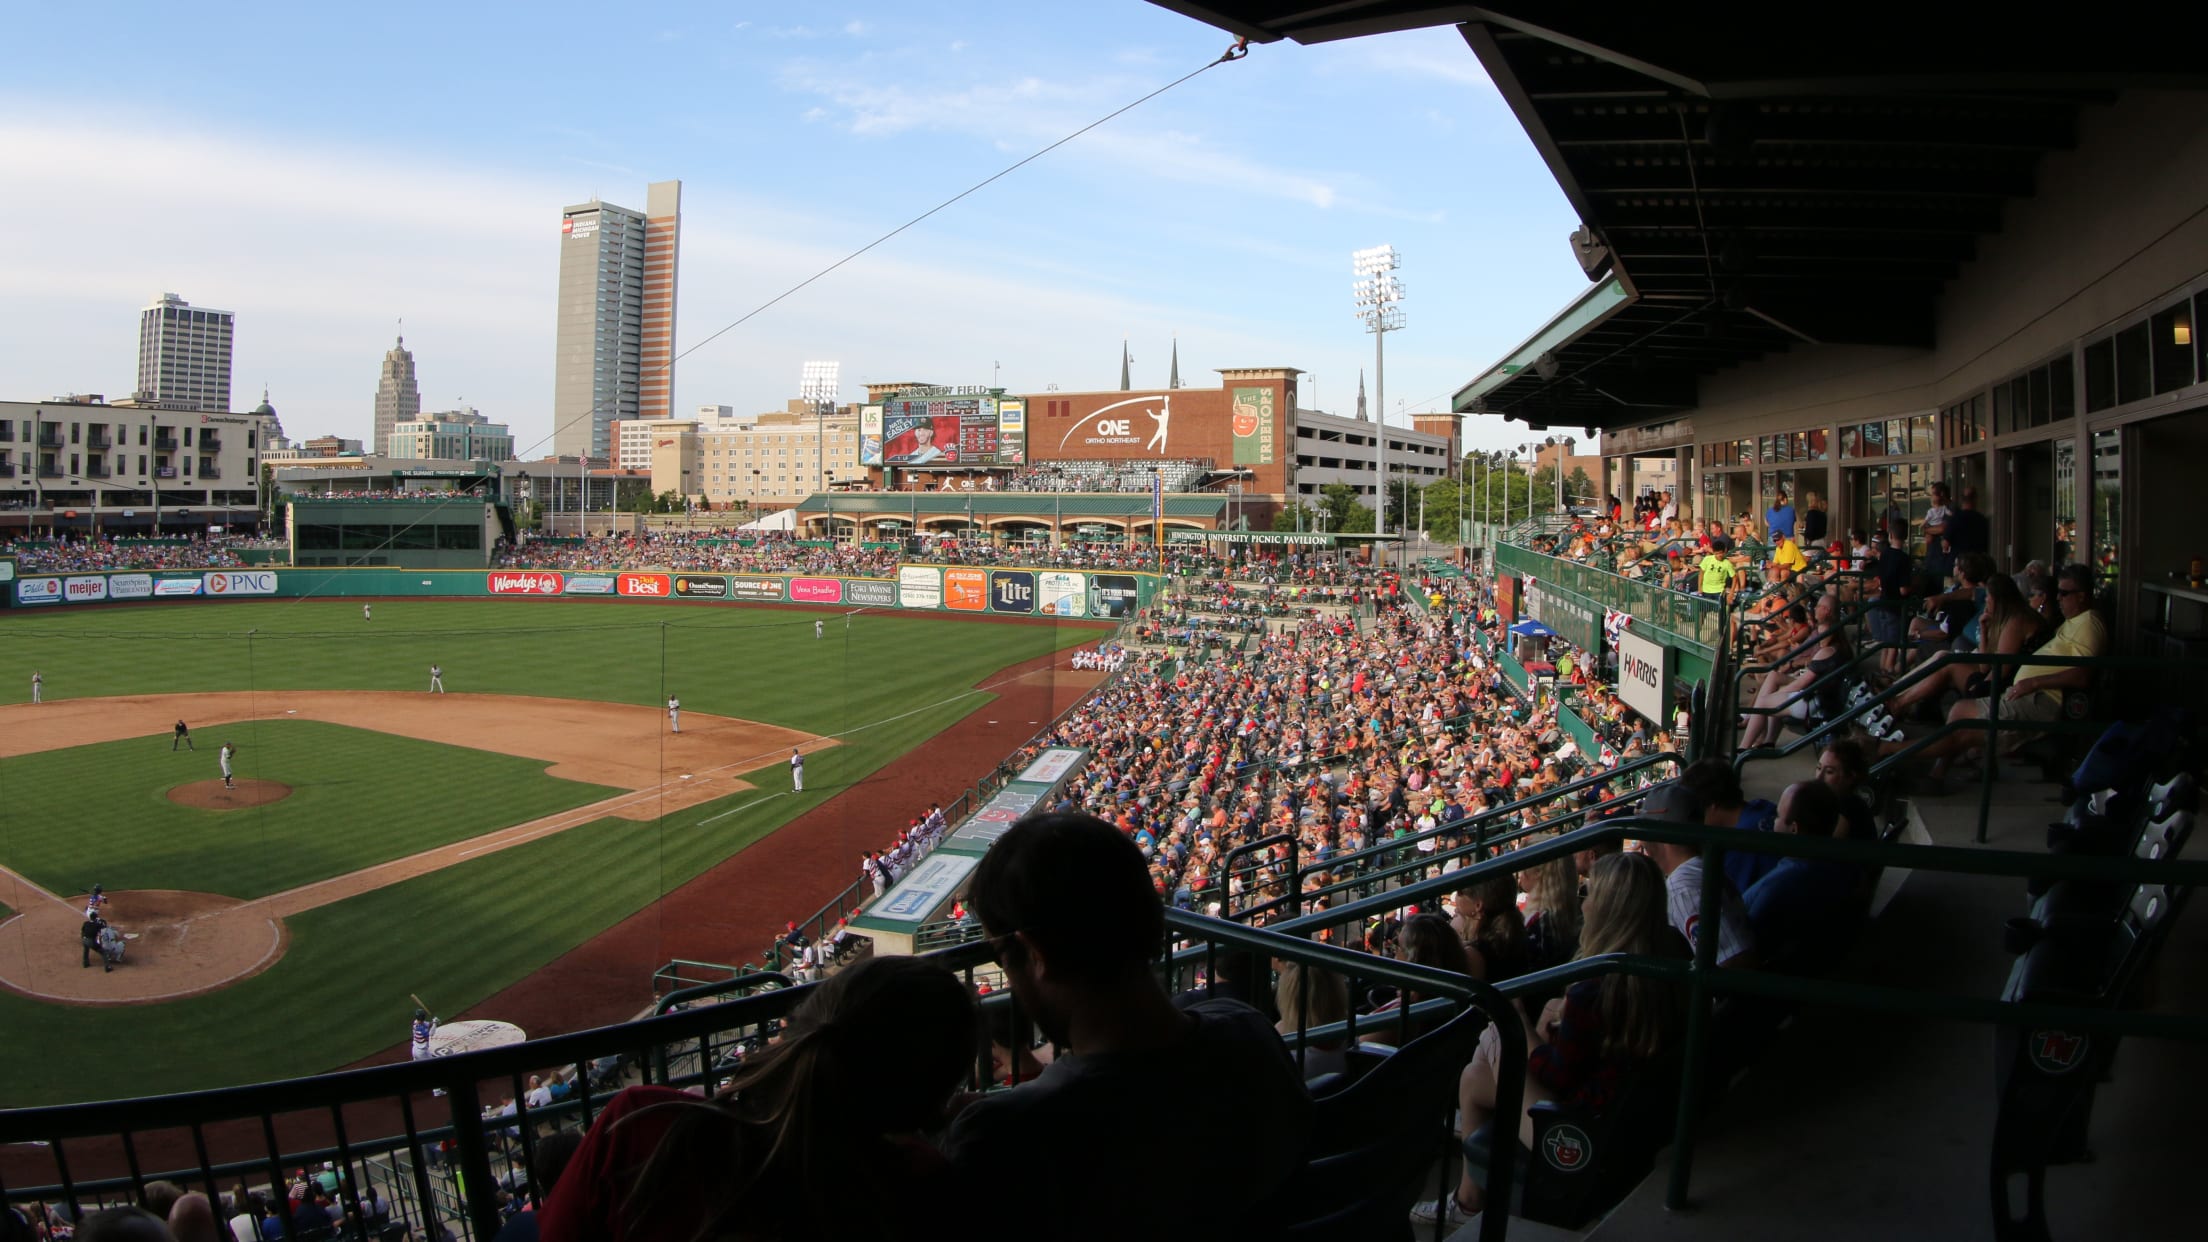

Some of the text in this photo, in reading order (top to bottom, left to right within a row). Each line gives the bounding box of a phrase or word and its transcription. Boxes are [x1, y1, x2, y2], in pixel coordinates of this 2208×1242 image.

[957, 385, 987, 395] FIELD
[1243, 395, 1257, 403] THE
[886, 418, 914, 439] EASLEY
[888, 418, 904, 430] NATE
[1097, 419, 1131, 436] ONE
[1260, 388, 1272, 463] TREETOPS
[961, 480, 975, 488] ONE
[1171, 531, 1328, 545] HUNTINGTON UNIVERSITY PICNIC PAVILION
[69, 580, 103, 597] meijer
[232, 574, 271, 591] PNC
[494, 574, 537, 593] Wendy's
[628, 578, 660, 594] Best
[735, 581, 761, 590] SOURCE
[850, 583, 893, 594] FORT WAYNE
[796, 585, 837, 597] Vera Bradley
[851, 592, 893, 602] NEWSPAPERS
[1001, 582, 1032, 605] Lite
[1624, 652, 1658, 689] HARRIS
